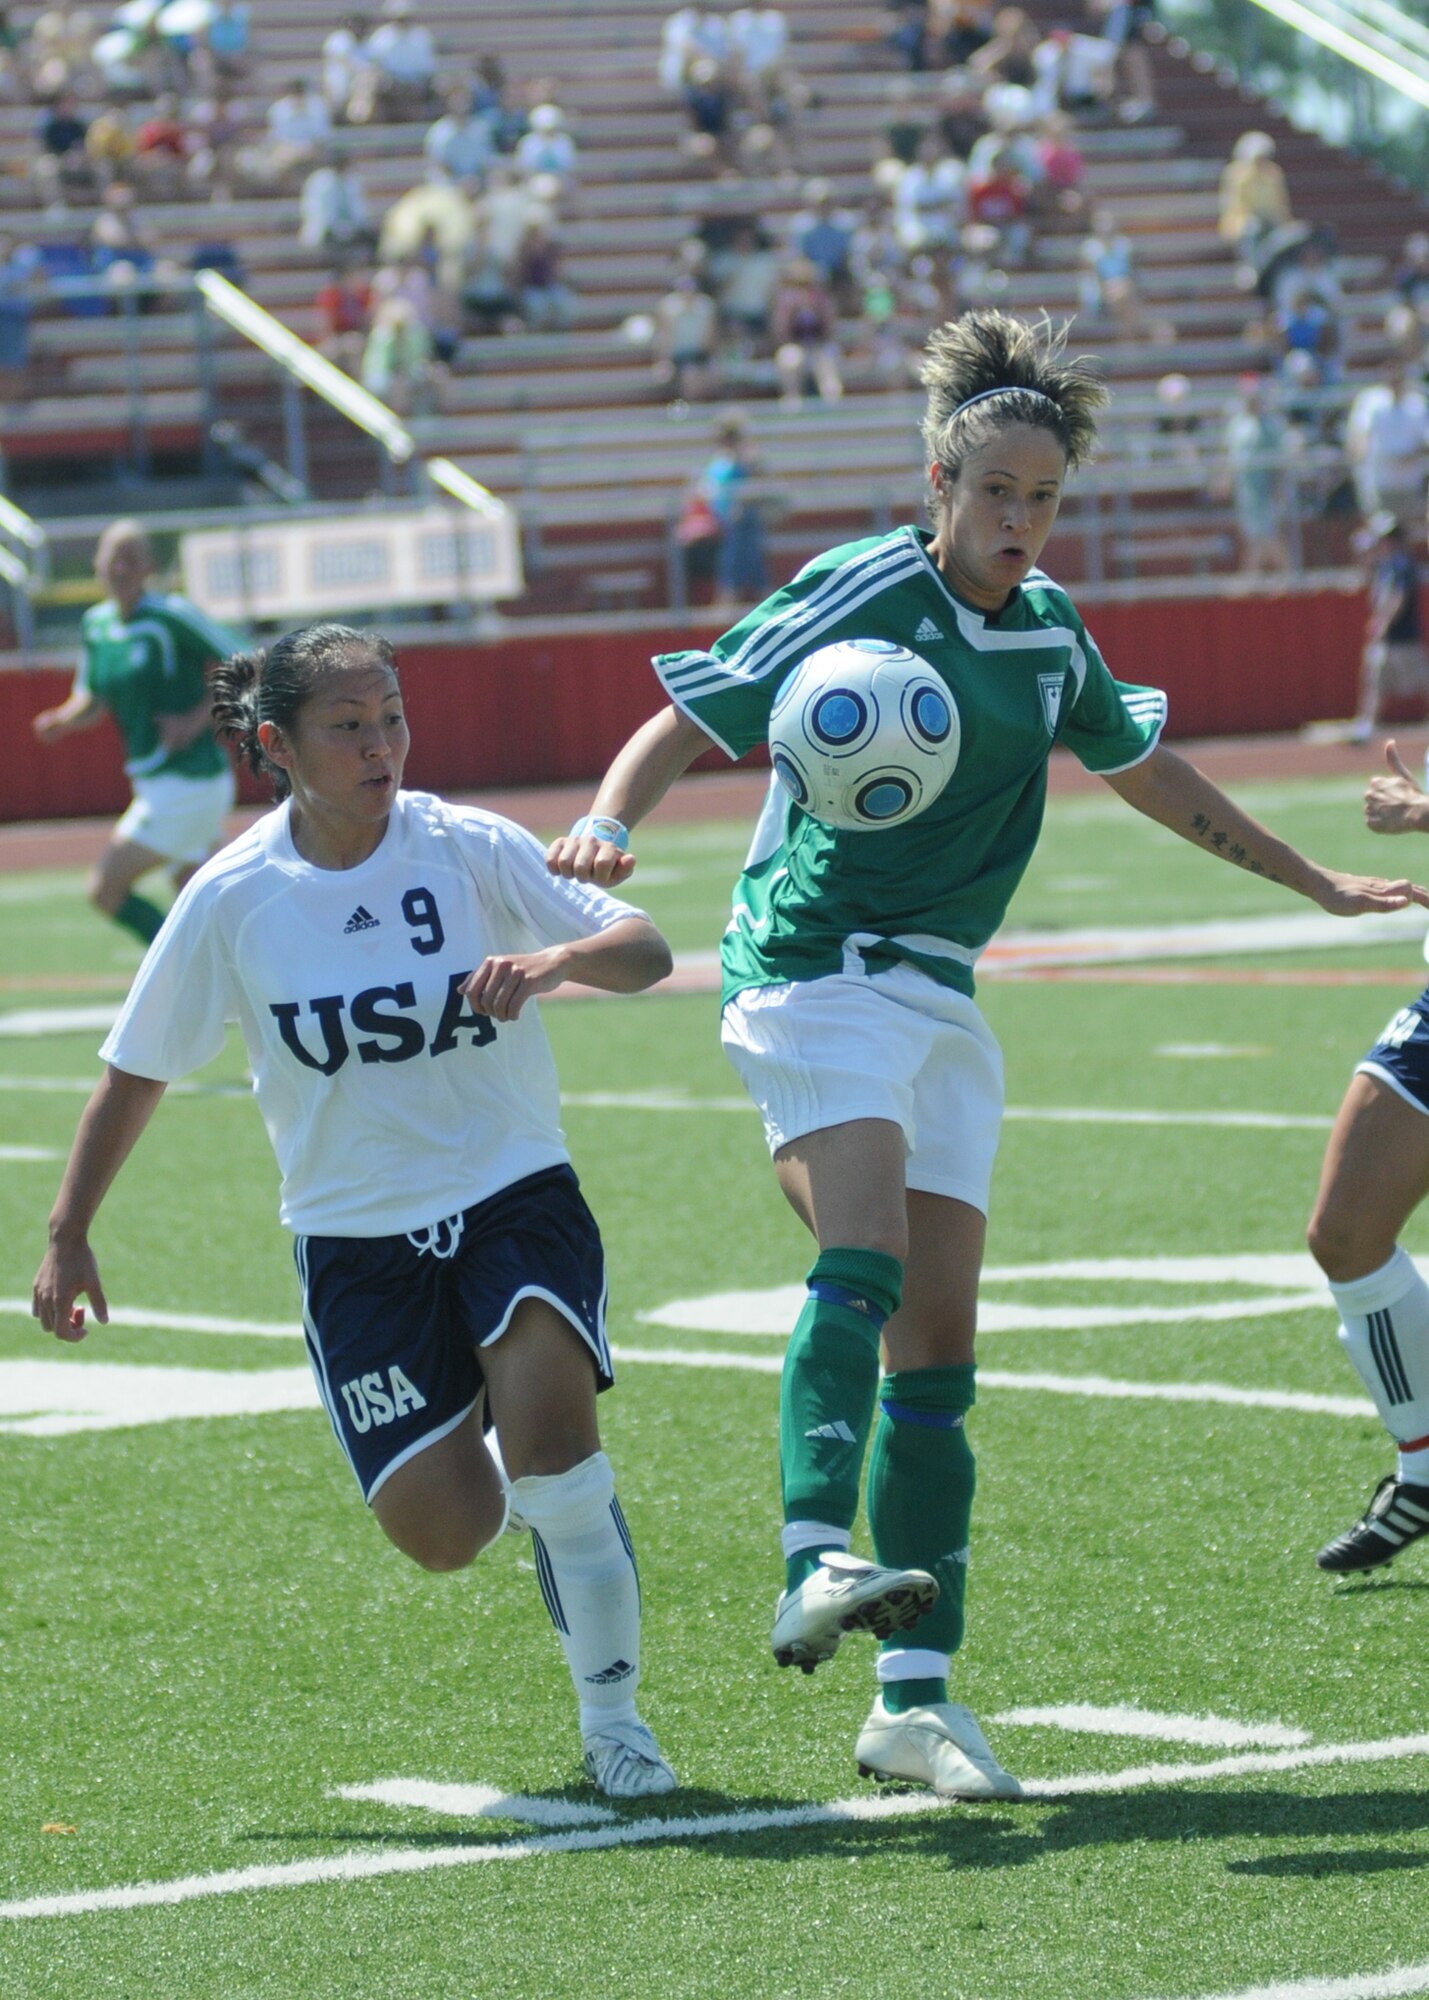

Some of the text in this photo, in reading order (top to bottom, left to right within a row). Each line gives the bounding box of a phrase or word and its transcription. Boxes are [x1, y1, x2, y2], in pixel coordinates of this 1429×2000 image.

[915, 631, 944, 641] adidas
[343, 918, 380, 934] adidas
[401, 887, 445, 956] 9
[269, 970, 497, 1076] USA
[340, 1365, 427, 1434] USA
